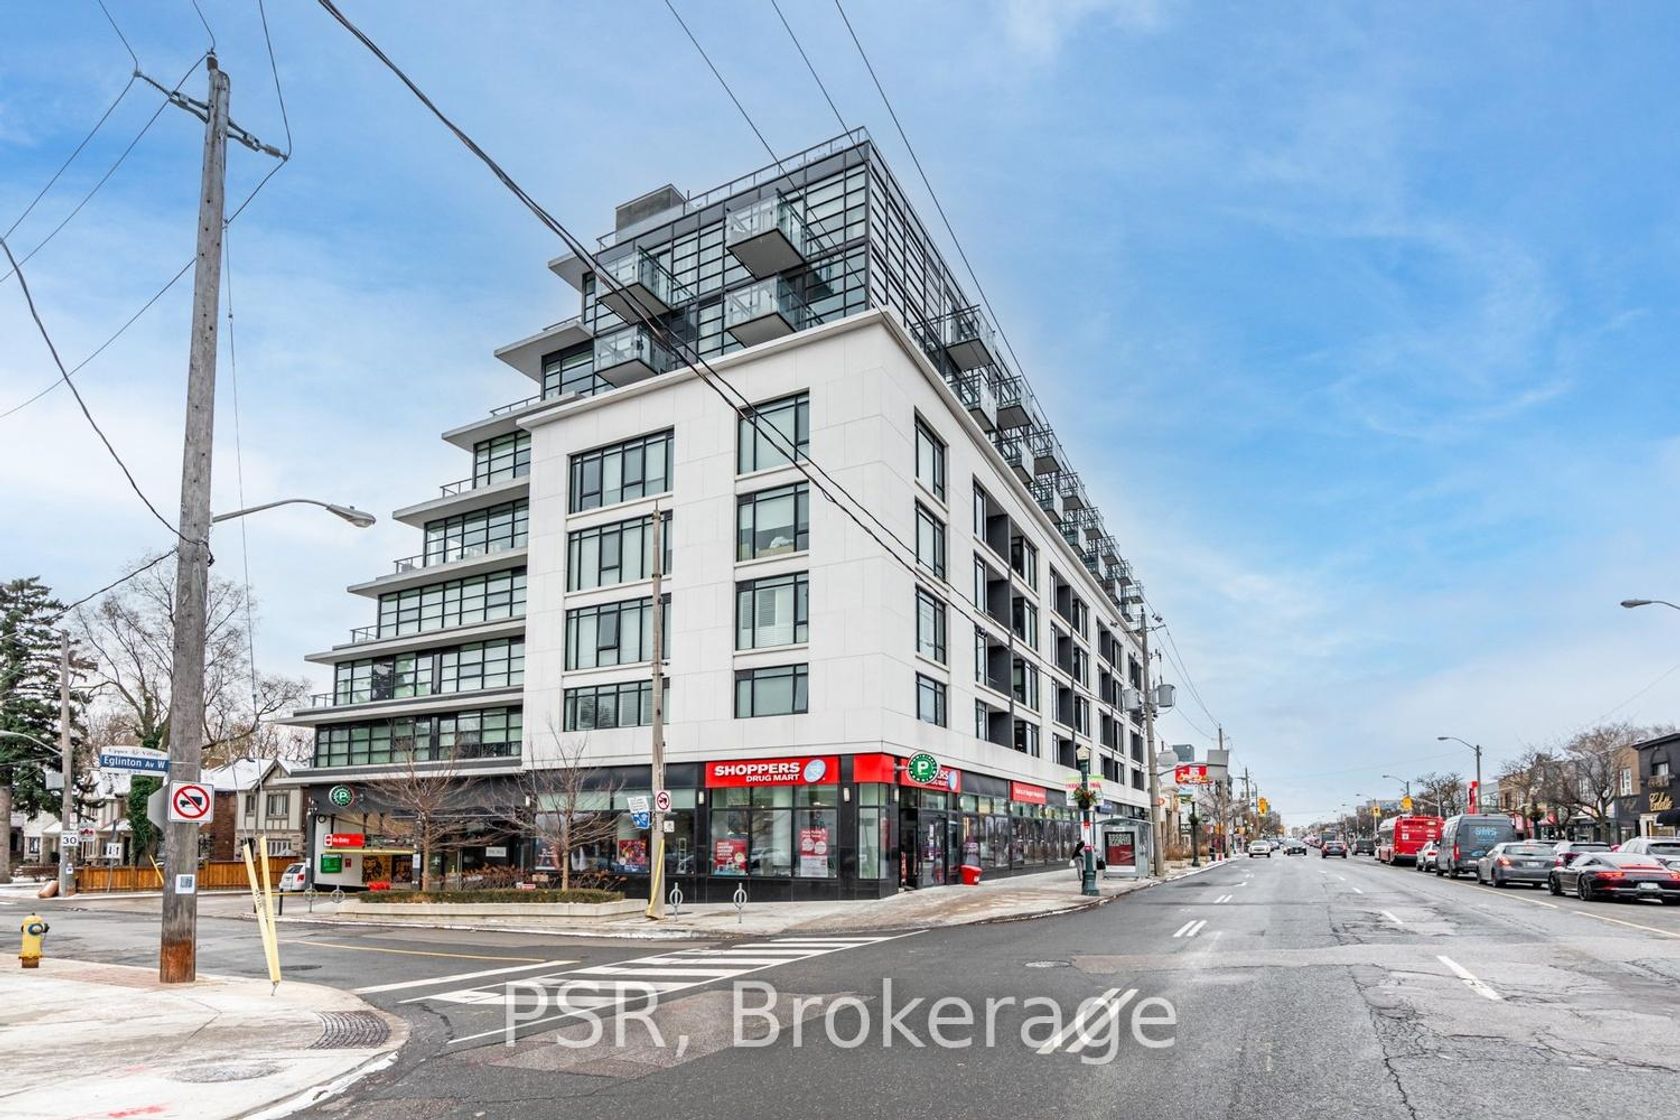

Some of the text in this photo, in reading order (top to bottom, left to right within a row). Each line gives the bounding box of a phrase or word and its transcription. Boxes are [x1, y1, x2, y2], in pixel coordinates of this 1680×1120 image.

[104, 756, 166, 769] Eglinton Av W
[917, 760, 929, 775] P
[714, 762, 801, 777] SHOPPERS
[746, 773, 800, 783] DRUG MART
[339, 791, 348, 801] P
[63, 836, 77, 845] 30
